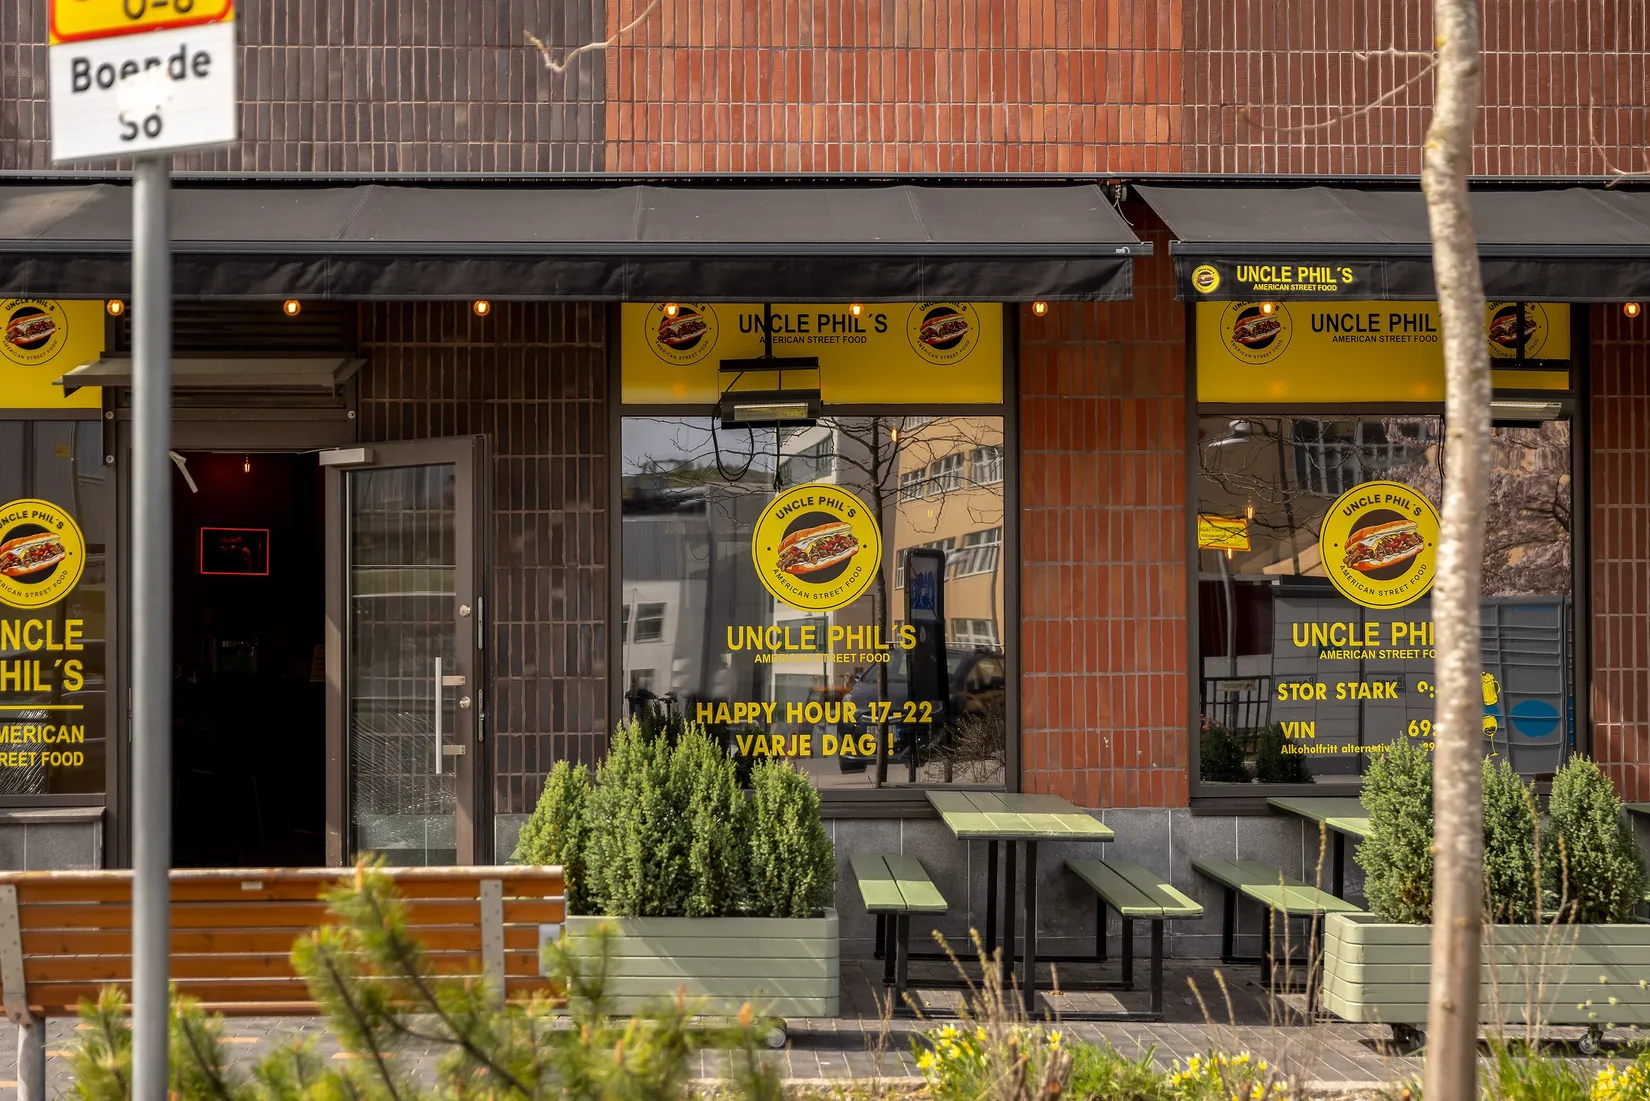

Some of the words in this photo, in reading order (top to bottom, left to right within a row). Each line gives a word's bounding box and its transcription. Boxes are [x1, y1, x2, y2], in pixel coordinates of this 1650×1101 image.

[1236, 265, 1292, 283] UNCLE
[1252, 283, 1289, 291] AMERICAN
[739, 314, 809, 333] UNCLE
[1311, 313, 1381, 333] UNCLE
[759, 336, 805, 344] AERICAN
[807, 336, 839, 344] STREET
[843, 336, 867, 344] FOOD
[1332, 335, 1377, 343] AMERICAN
[1379, 335, 1411, 343] STREET
[1414, 335, 1438, 343] FOOD
[3, 340, 25, 360] AMERICAN
[26, 353, 46, 361] STREET
[46, 340, 58, 354] FOOD
[655, 340, 677, 360] AMERICAN
[678, 352, 698, 360] STREET
[917, 340, 939, 359] AMERICAN
[940, 352, 959, 360] STREET
[1230, 340, 1252, 358] AMERICAN
[1254, 351, 1272, 359] STREET
[775, 496, 814, 520] UNCLE
[1342, 494, 1381, 516] UNCLE
[25, 586, 52, 598] STREET
[53, 570, 68, 588] FOOD
[773, 568, 809, 599] AMERICAN
[813, 586, 844, 600] STREET
[845, 566, 862, 587] FOOD
[1339, 565, 1375, 595] AMERICAN
[1378, 584, 1409, 597] STREET
[1410, 564, 1427, 585] FOOD
[0, 619, 84, 651] NCLE
[727, 625, 816, 651] UNCLE
[1292, 622, 1380, 648] UNCLE
[754, 653, 811, 663] AMERICAN
[815, 653, 857, 663] STREET
[859, 653, 891, 663] FOOD
[1319, 650, 1376, 660] AMERICAN
[1379, 649, 1420, 659] STREET
[1277, 682, 1327, 700] STOR
[1336, 681, 1399, 700] STARK
[696, 702, 777, 724] HAPPY
[786, 702, 856, 724] HOUR
[868, 701, 933, 723] 17-22
[1280, 721, 1315, 739] VIN
[736, 734, 812, 756] VARJE
[822, 734, 877, 756] DAG
[1281, 744, 1338, 755] Alkoholfritt
[42, 751, 84, 767] FOOD
